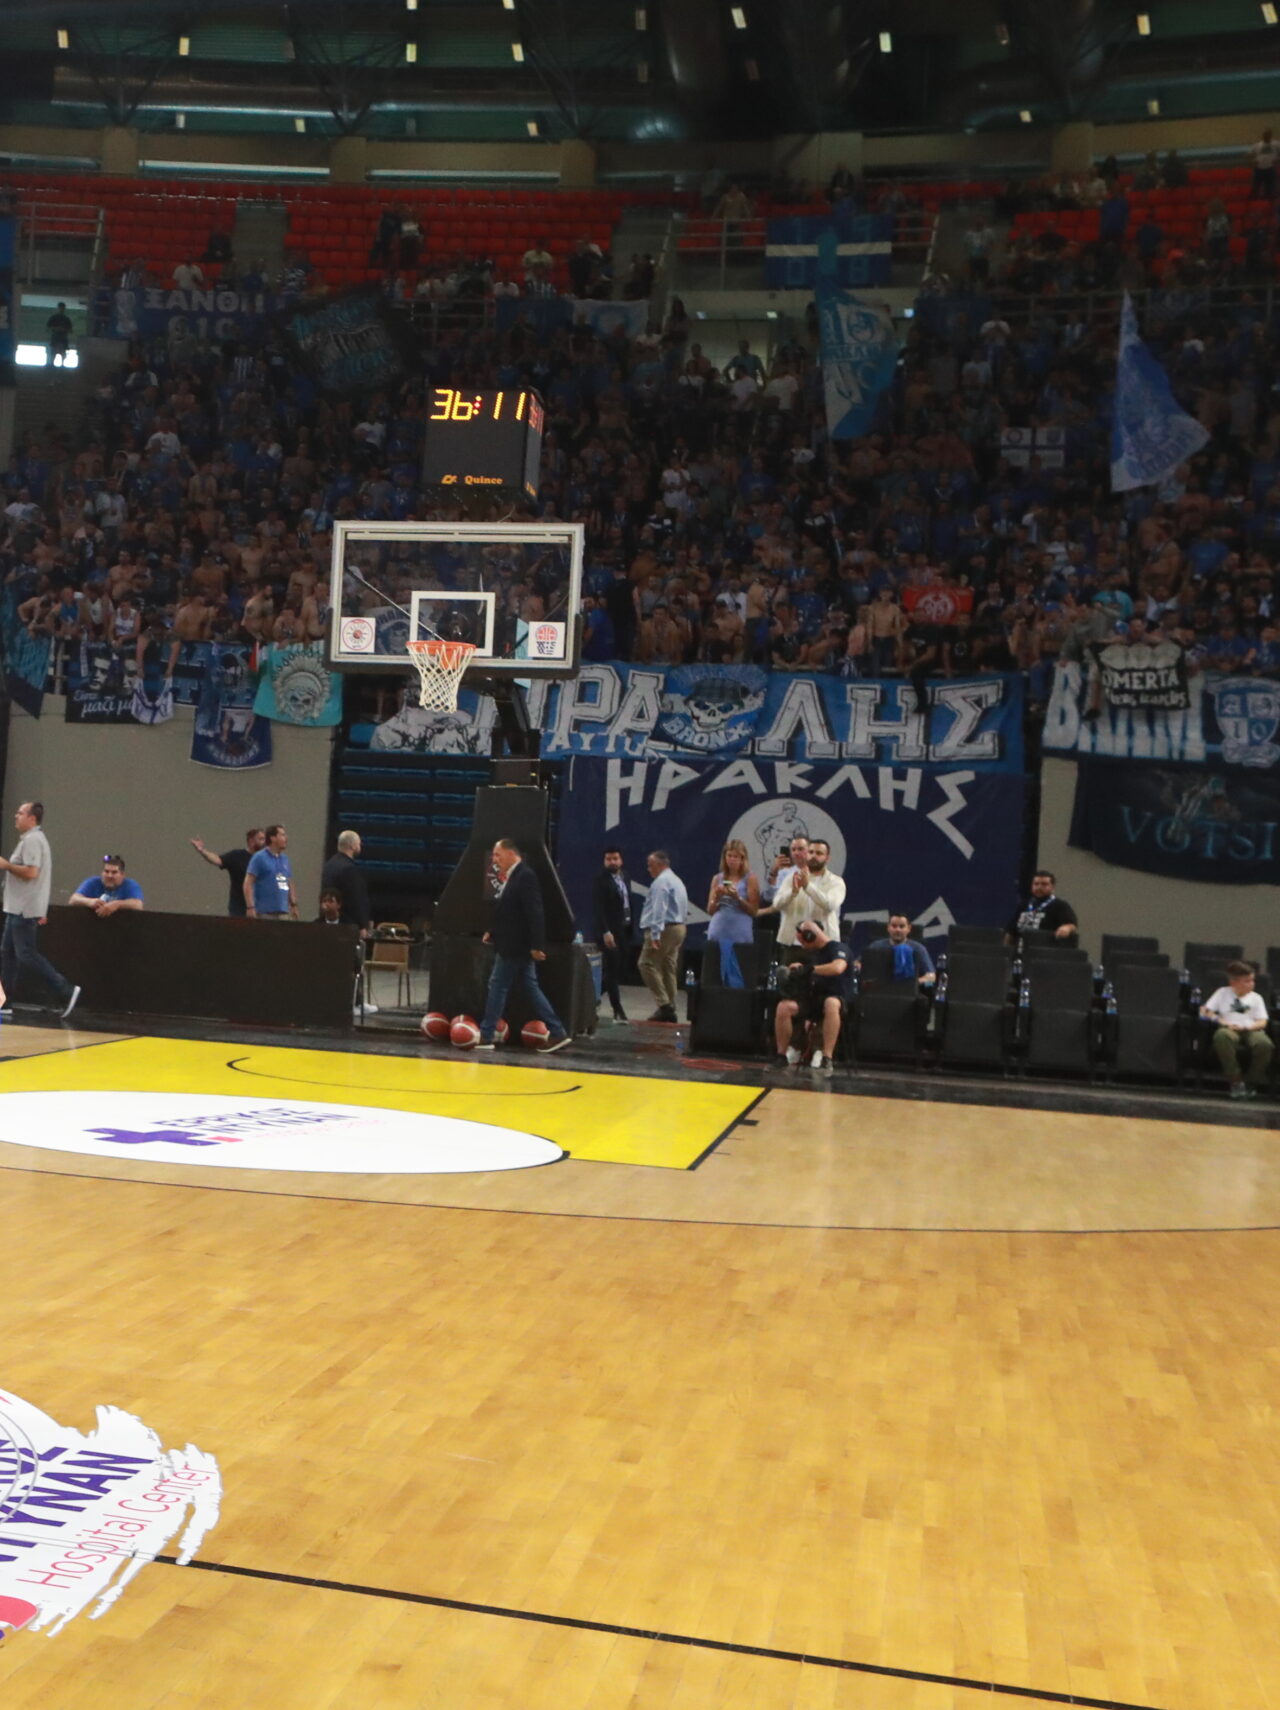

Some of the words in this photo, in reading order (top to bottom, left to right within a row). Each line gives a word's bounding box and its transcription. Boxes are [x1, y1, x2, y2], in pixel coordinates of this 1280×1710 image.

[430, 388, 526, 420] 36:11
[464, 475, 503, 485] Quince
[662, 716, 753, 749] BRONX
[605, 758, 976, 860] ΗΡΑΚΛΗΣ
[15, 1513, 151, 1589] Hospital
[117, 1463, 220, 1514] Center
